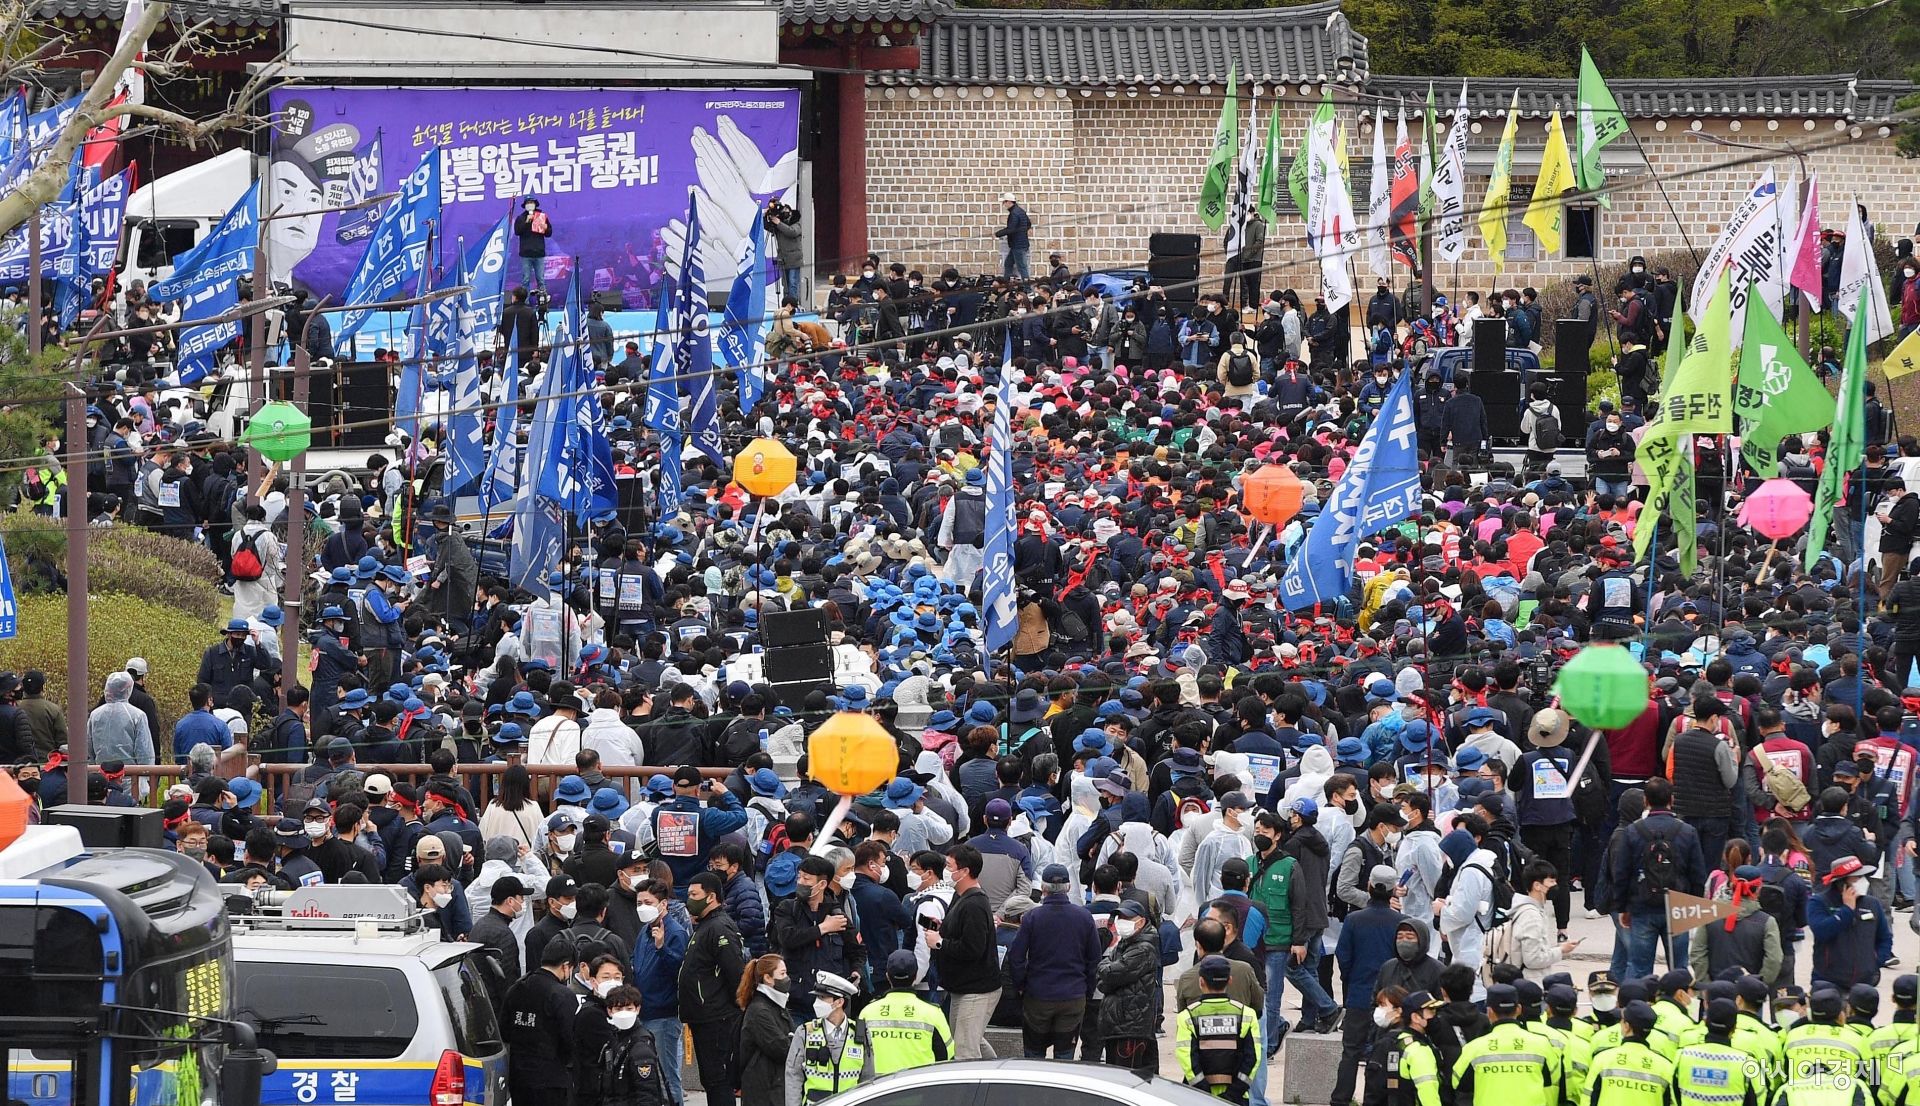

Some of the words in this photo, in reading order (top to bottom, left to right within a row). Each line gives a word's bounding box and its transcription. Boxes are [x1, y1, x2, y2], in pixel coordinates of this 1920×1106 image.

[411, 121, 454, 147] 윤석열
[458, 119, 513, 140] 당선자는
[517, 112, 563, 135] 노동자의
[569, 108, 598, 131] 요구를
[601, 104, 645, 129] 들어라!
[547, 131, 636, 166] 노동권
[326, 166, 351, 176] 차등적
[493, 163, 582, 200] 일자리
[589, 154, 659, 190] 쟁취!
[870, 1030, 923, 1041] POLICE
[1202, 1026, 1234, 1034] POLICE
[1796, 1047, 1848, 1059] POLICE
[1483, 1064, 1533, 1074] POLICE
[292, 1070, 360, 1103] 경찰
[1608, 1079, 1658, 1094] POLICE
